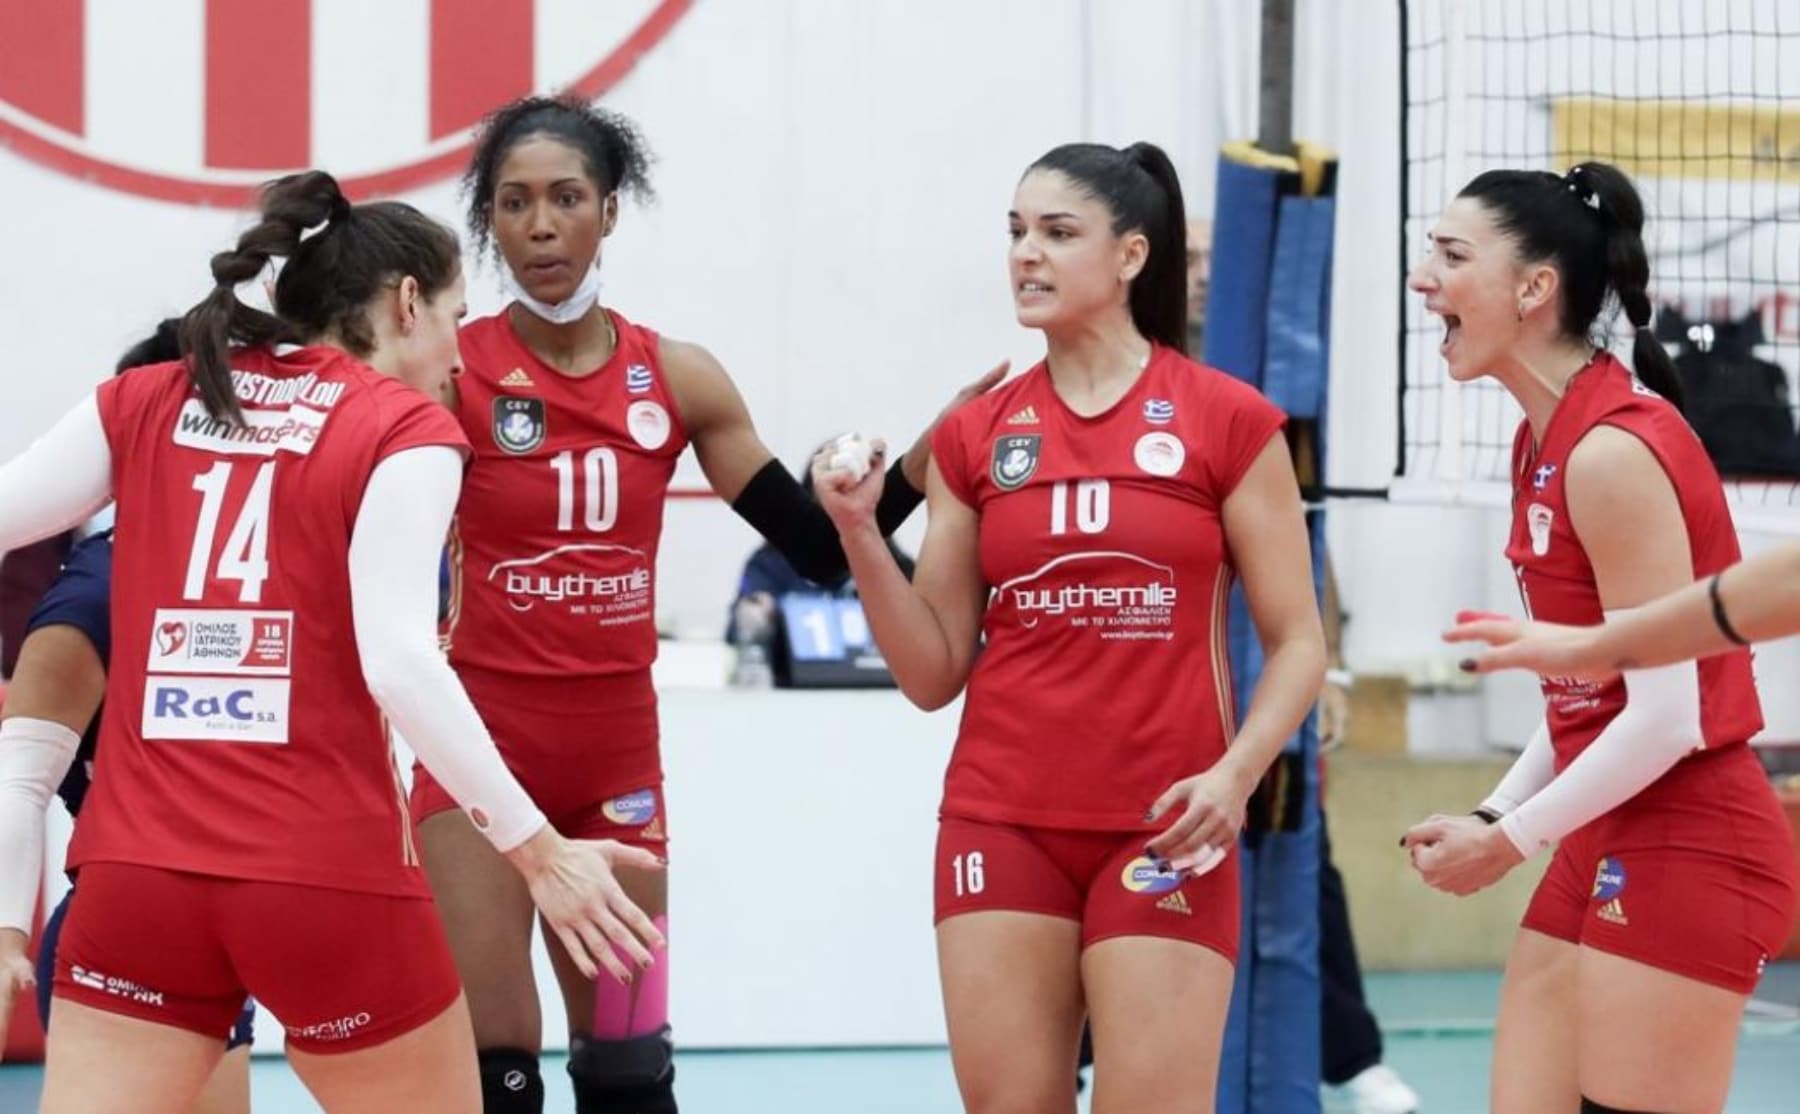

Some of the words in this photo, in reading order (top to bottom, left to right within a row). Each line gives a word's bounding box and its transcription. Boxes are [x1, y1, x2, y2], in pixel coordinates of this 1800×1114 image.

[181, 412, 322, 444] winmasers
[551, 449, 618, 531] 10
[184, 461, 275, 603] 14
[154, 687, 254, 720] RaC
[953, 852, 984, 895] 16
